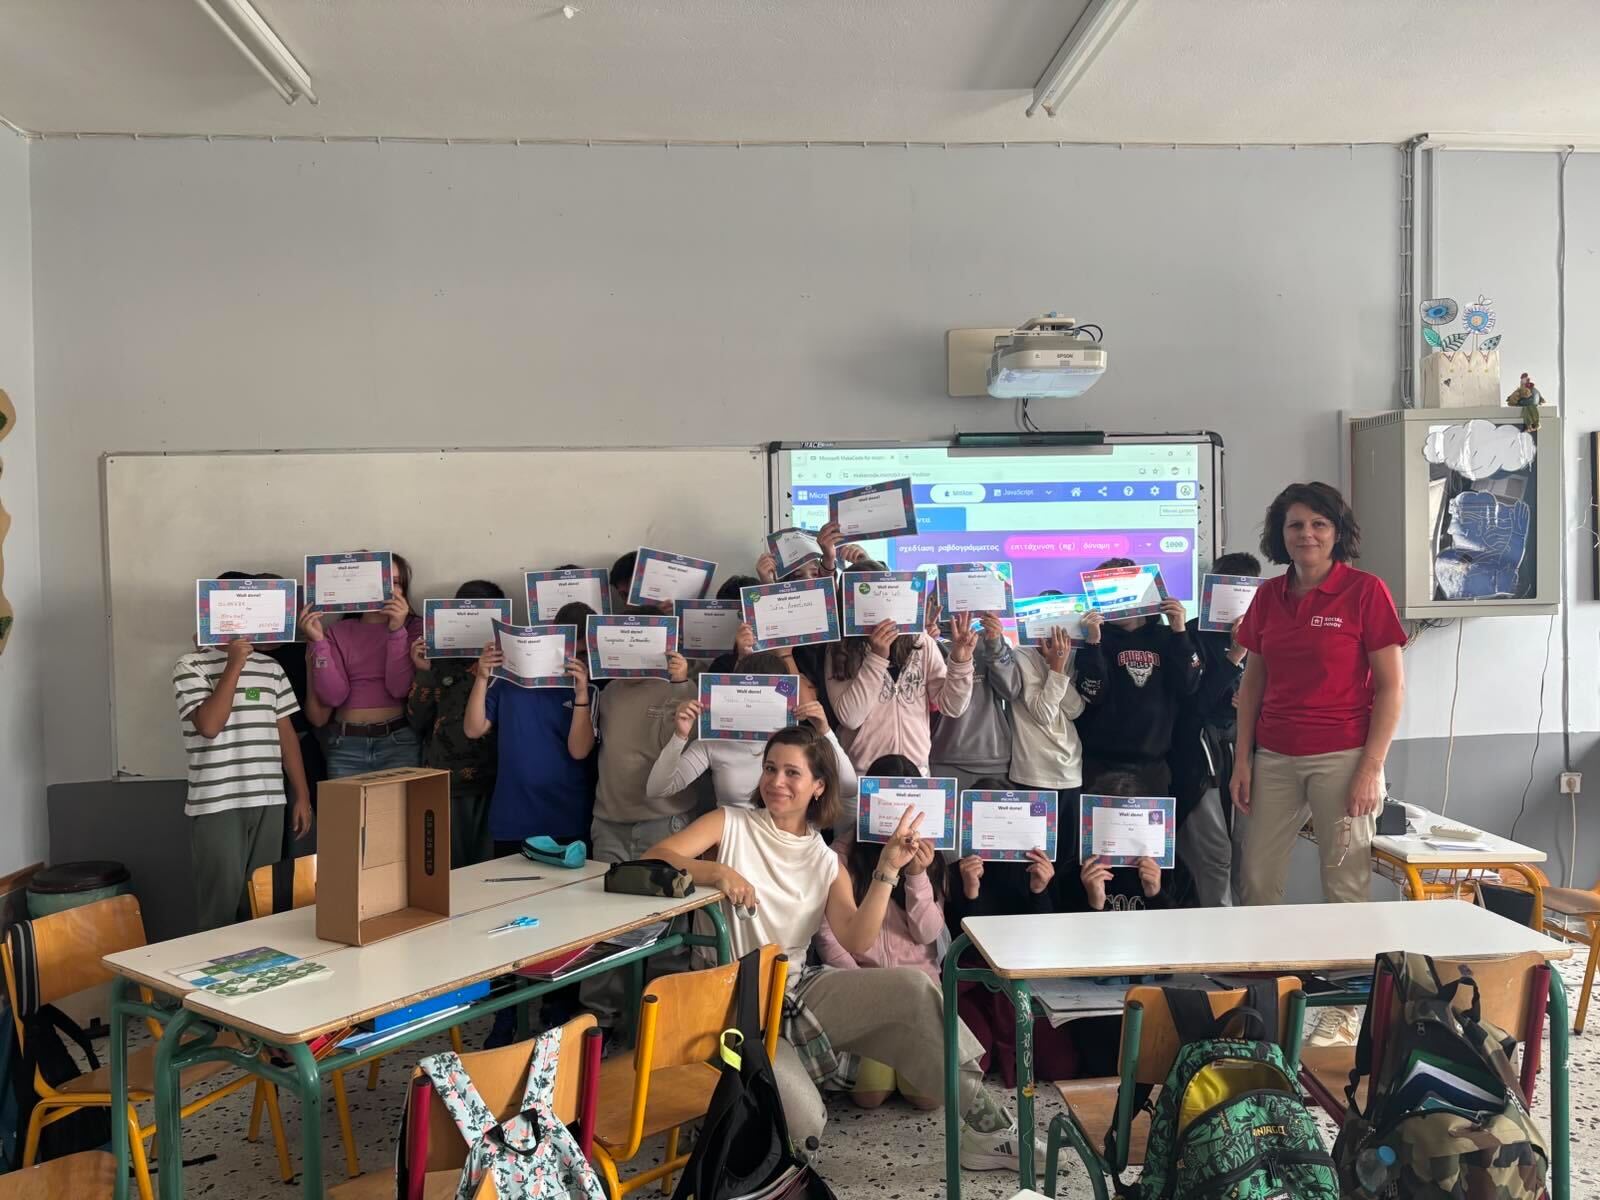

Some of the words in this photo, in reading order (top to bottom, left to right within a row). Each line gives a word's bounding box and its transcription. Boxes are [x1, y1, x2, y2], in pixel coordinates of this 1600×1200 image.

[899, 544, 934, 552] σχεδίαση
[938, 544, 1000, 553] ραβδογράμματος
[1010, 543, 1055, 551] επιτάχυνση
[1059, 542, 1075, 550] (mg)
[1083, 542, 1110, 550] δύναμη
[1118, 650, 1160, 666] CHICAGO
